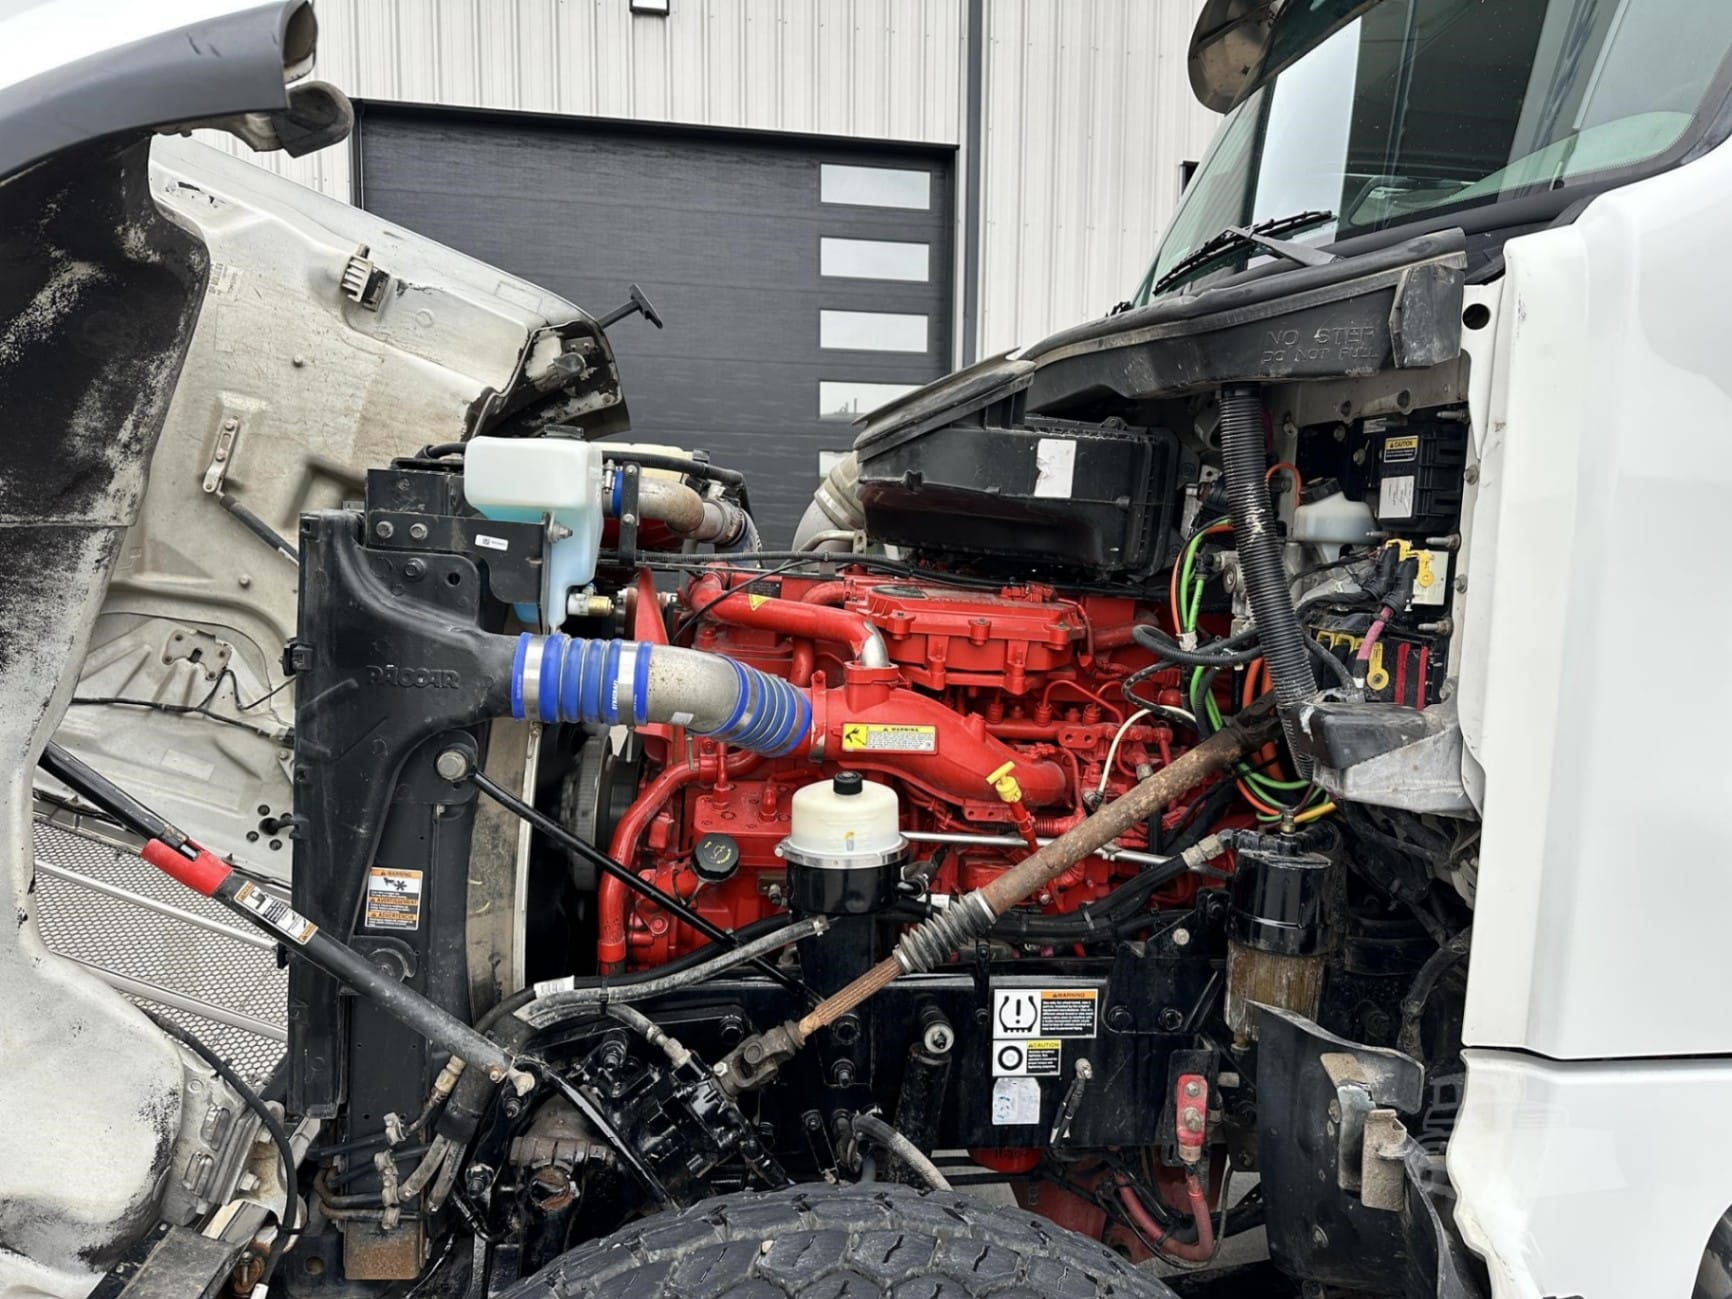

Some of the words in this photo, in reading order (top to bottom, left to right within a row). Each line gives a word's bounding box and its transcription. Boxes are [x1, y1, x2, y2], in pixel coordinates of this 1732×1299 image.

[1266, 329, 1299, 345] NO
[1314, 326, 1376, 345] STEP
[1294, 347, 1330, 362] NOT
